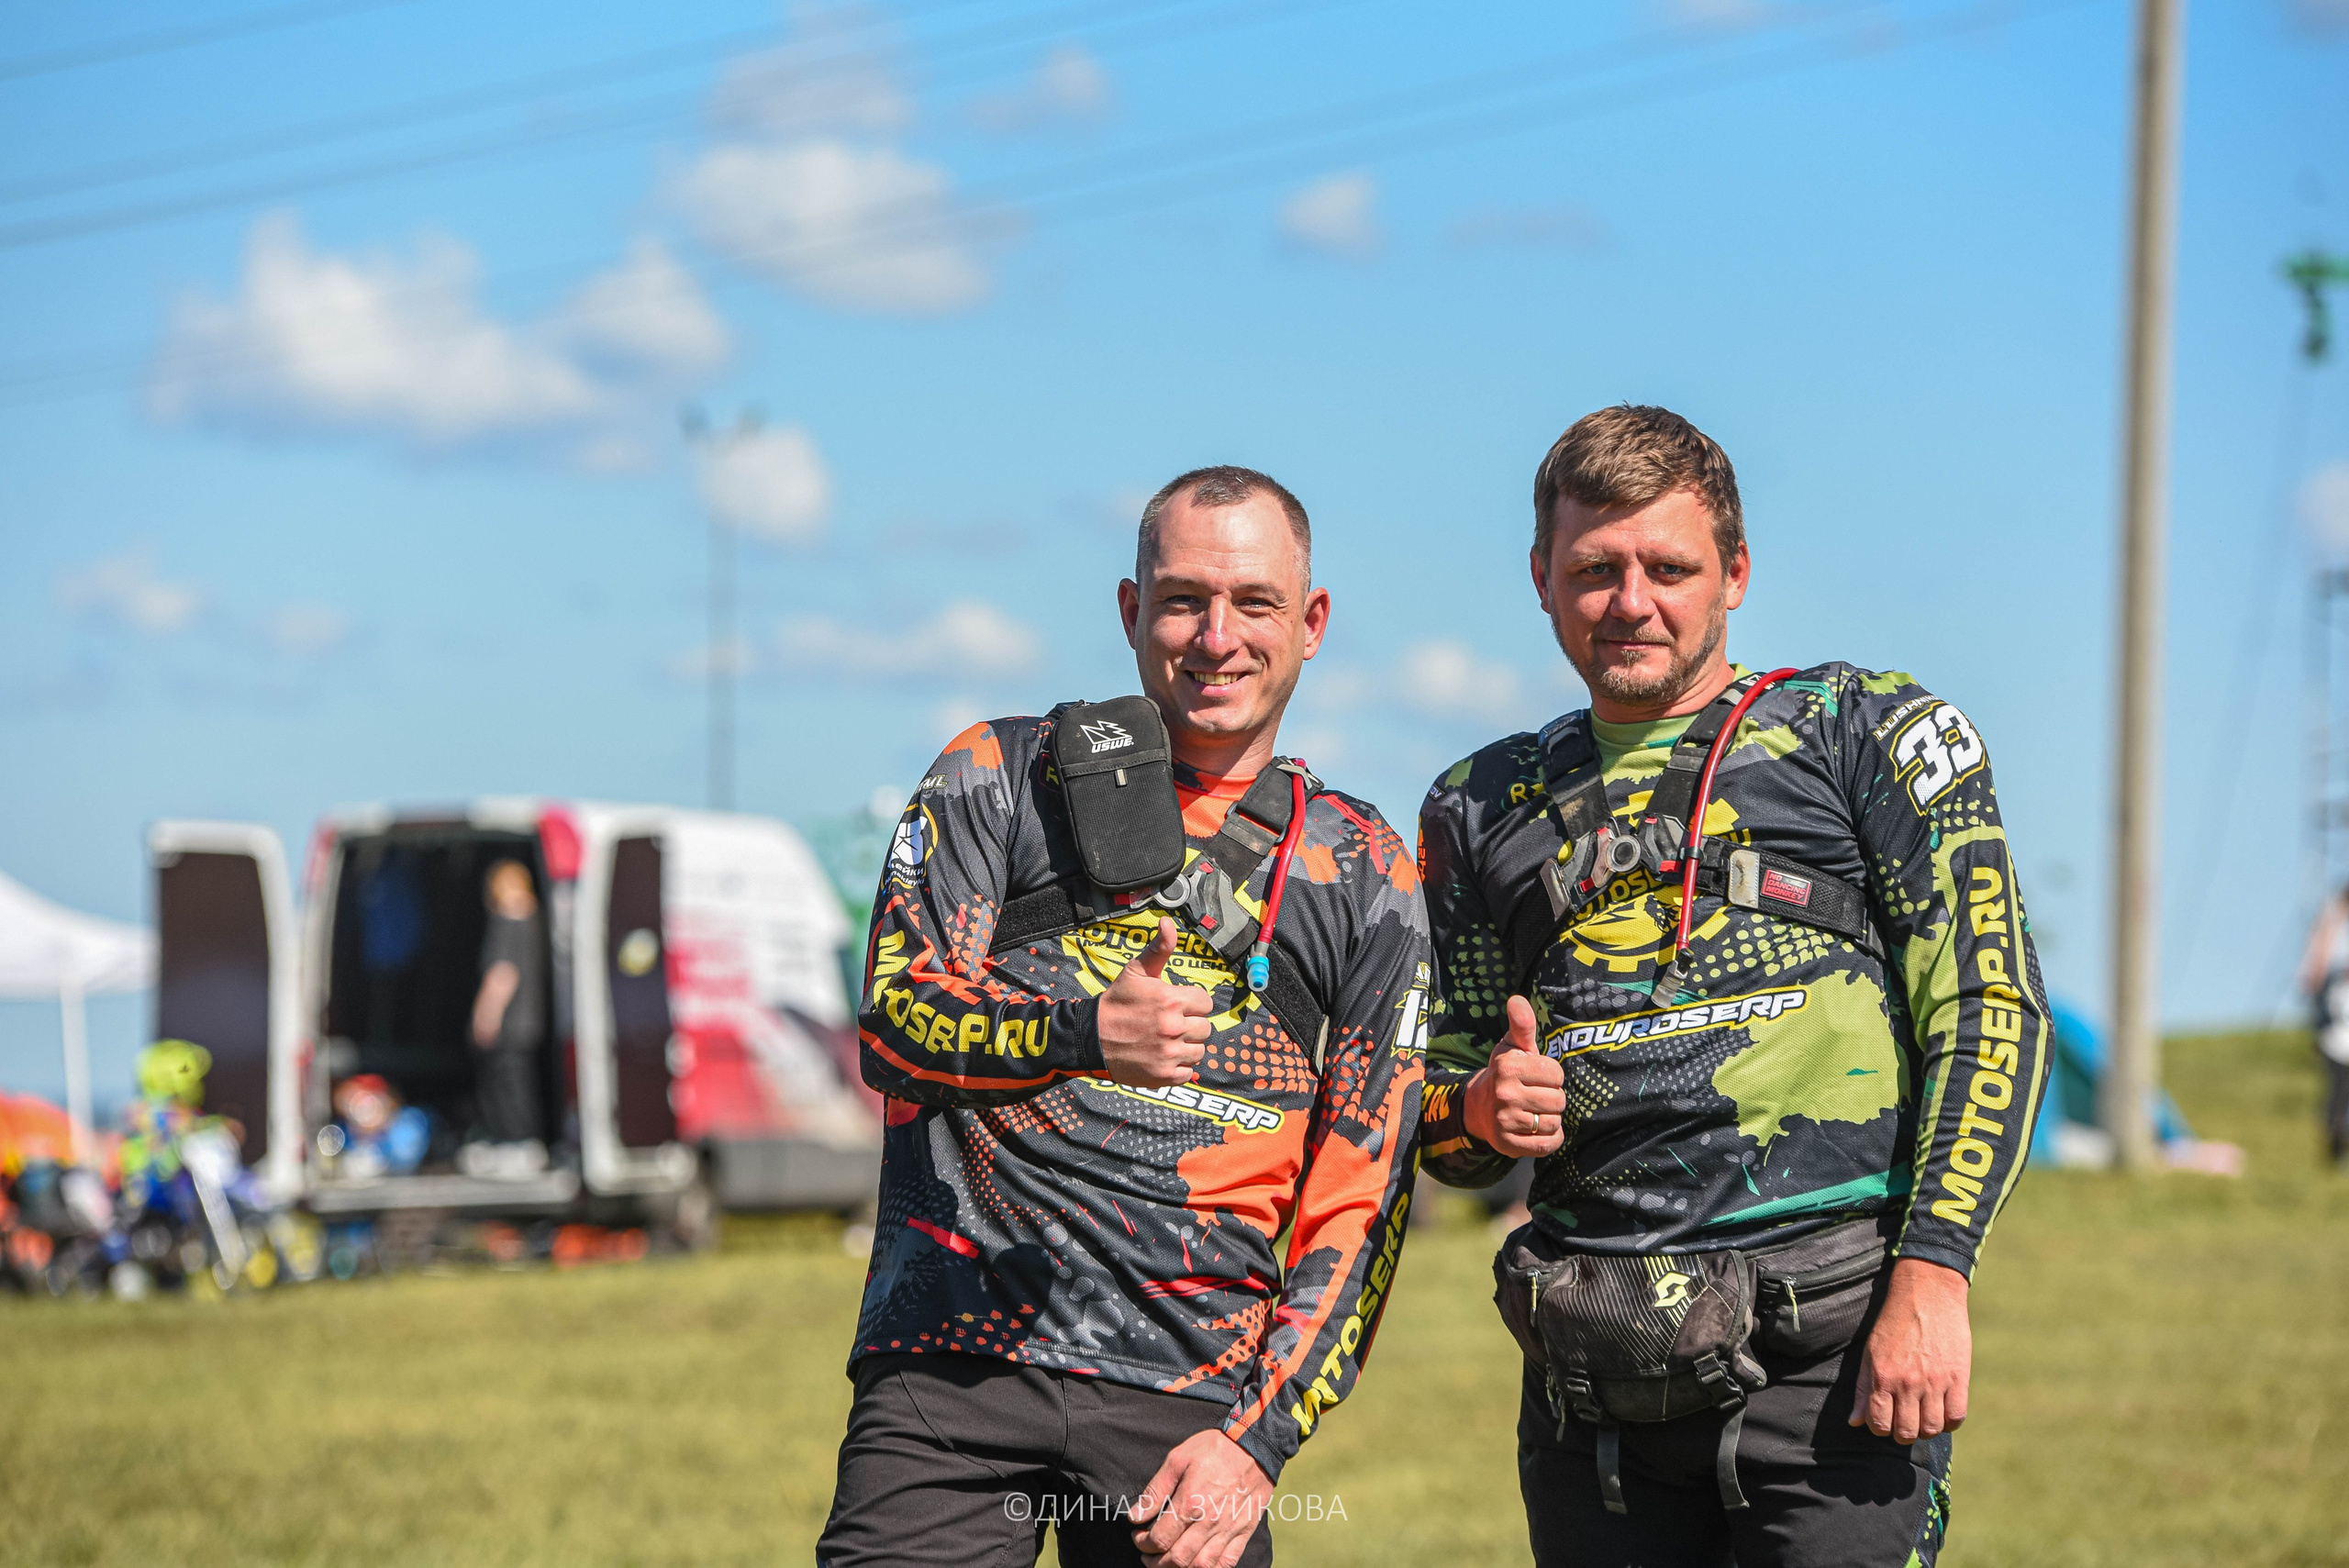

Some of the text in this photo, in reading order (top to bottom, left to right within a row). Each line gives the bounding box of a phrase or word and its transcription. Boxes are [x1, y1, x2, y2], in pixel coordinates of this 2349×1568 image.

[1894, 704, 1984, 807] 33
[1765, 885, 1804, 900] MONKEY
[1766, 879, 1807, 895] DANCING
[1768, 873, 1783, 882] NO
[1544, 990, 1807, 1059] ENDUROSERP
[1931, 866, 2022, 1229] MOTOSERP.RU
